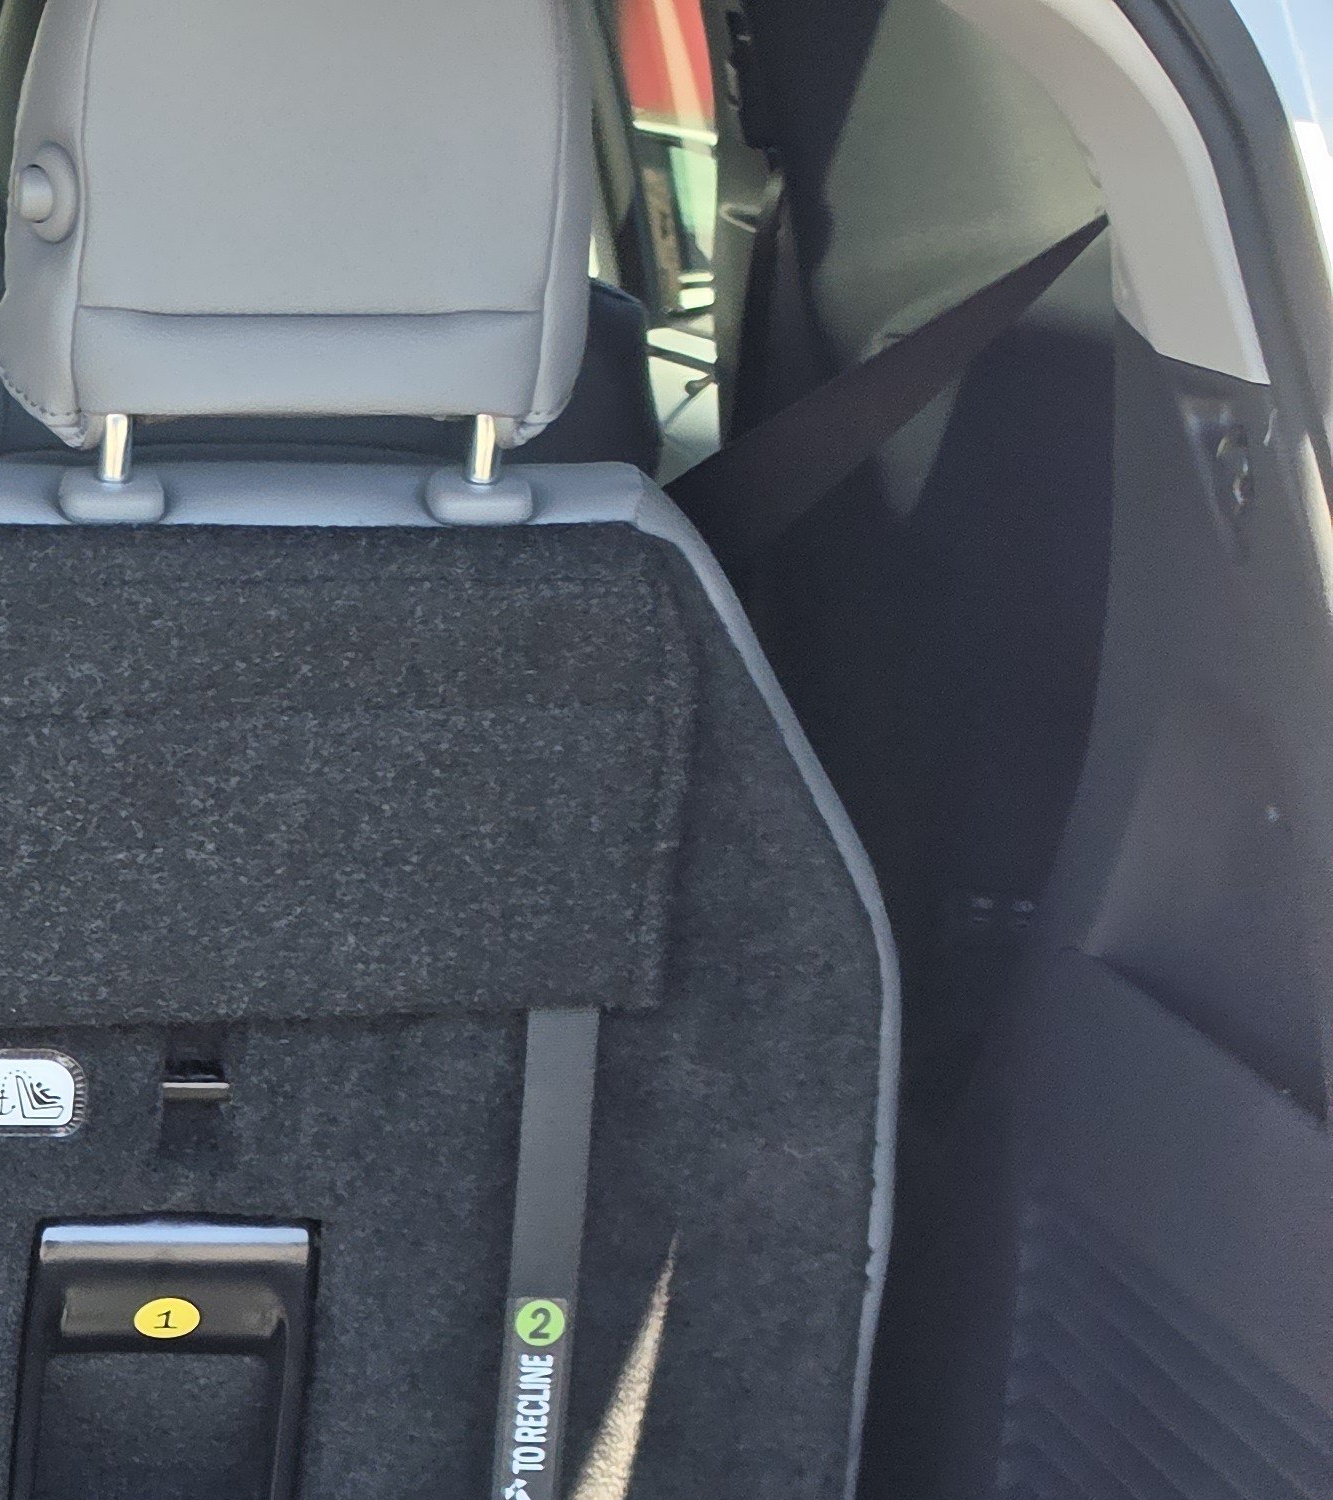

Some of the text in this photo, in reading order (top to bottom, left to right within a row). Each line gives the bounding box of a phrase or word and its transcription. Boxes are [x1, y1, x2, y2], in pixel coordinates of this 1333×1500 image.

[154, 1310, 177, 1328] 1
[529, 1308, 551, 1339] 2
[512, 1354, 554, 1475] TO RECLINE
